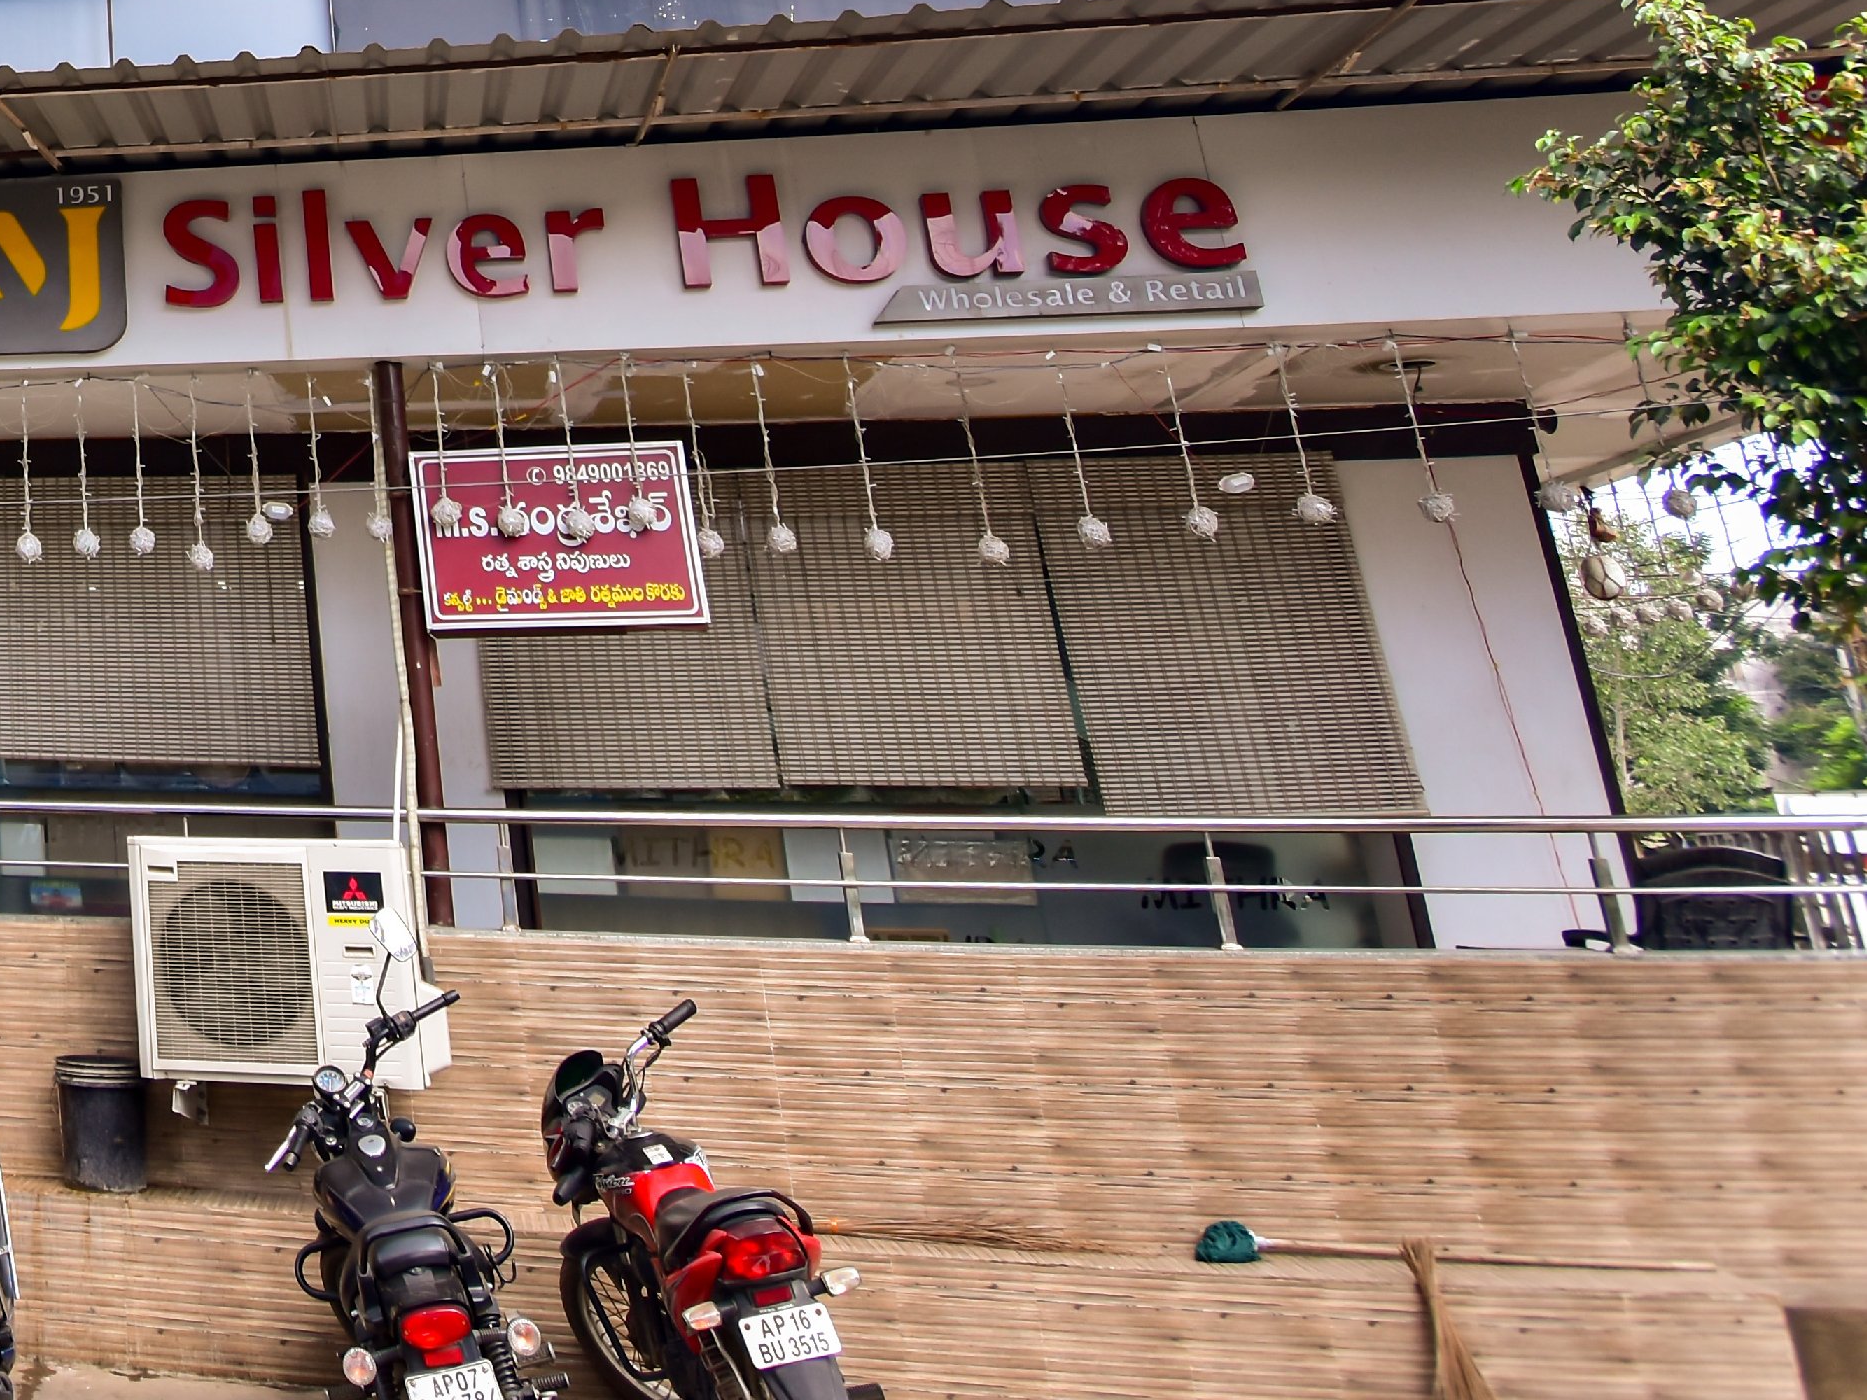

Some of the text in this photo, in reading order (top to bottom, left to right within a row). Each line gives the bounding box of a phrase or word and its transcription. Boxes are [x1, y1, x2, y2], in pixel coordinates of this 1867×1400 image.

[56, 185, 112, 204] 1951
[162, 172, 1247, 309] Silver House
[919, 275, 1247, 312] Wholesale & Retail
[1140, 876, 1332, 911] MIHRA
[761, 1309, 812, 1339] AP 16
